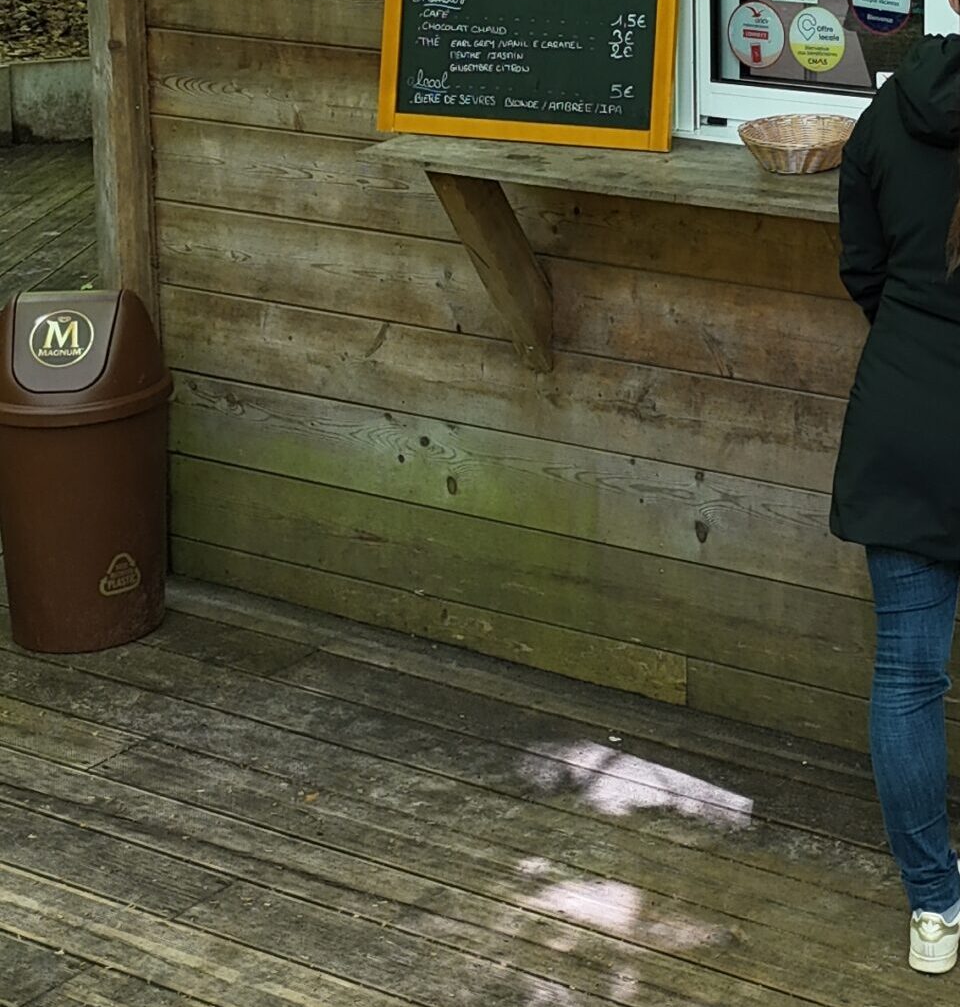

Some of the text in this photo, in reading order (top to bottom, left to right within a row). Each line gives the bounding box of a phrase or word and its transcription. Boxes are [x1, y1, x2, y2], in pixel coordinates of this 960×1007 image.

[610, 13, 647, 29] 1,5€
[421, 22, 469, 34] CHOCOLAT
[470, 24, 508, 35] CHAUD
[444, 95, 457, 104] DE
[38, 347, 84, 358] MAGNUM
